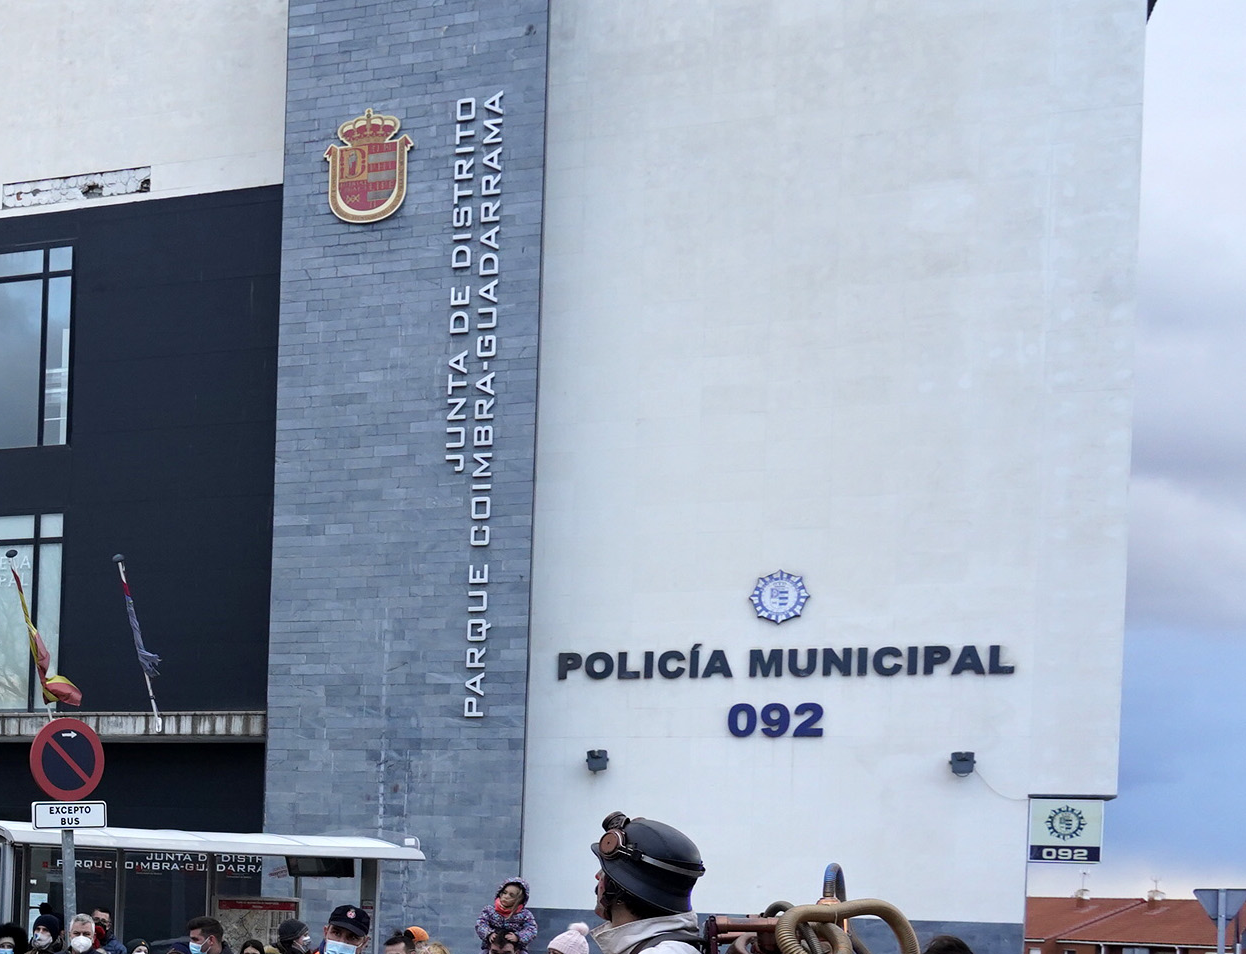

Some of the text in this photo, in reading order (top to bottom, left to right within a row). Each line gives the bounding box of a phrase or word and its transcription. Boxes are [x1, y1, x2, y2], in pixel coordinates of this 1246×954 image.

[446, 97, 476, 472] JUNTA DE DISTRITO
[464, 90, 504, 718] PARQUE COIMBRA-GUADARRAMA
[557, 643, 1015, 681] POLICÍA MUNICIPAL
[727, 702, 824, 738] 092
[49, 805, 92, 815] EXCEPTO
[60, 817, 80, 826] BUS
[146, 852, 193, 862] JUNTA
[1041, 847, 1089, 861] 092
[56, 859, 112, 870] PRQUE
